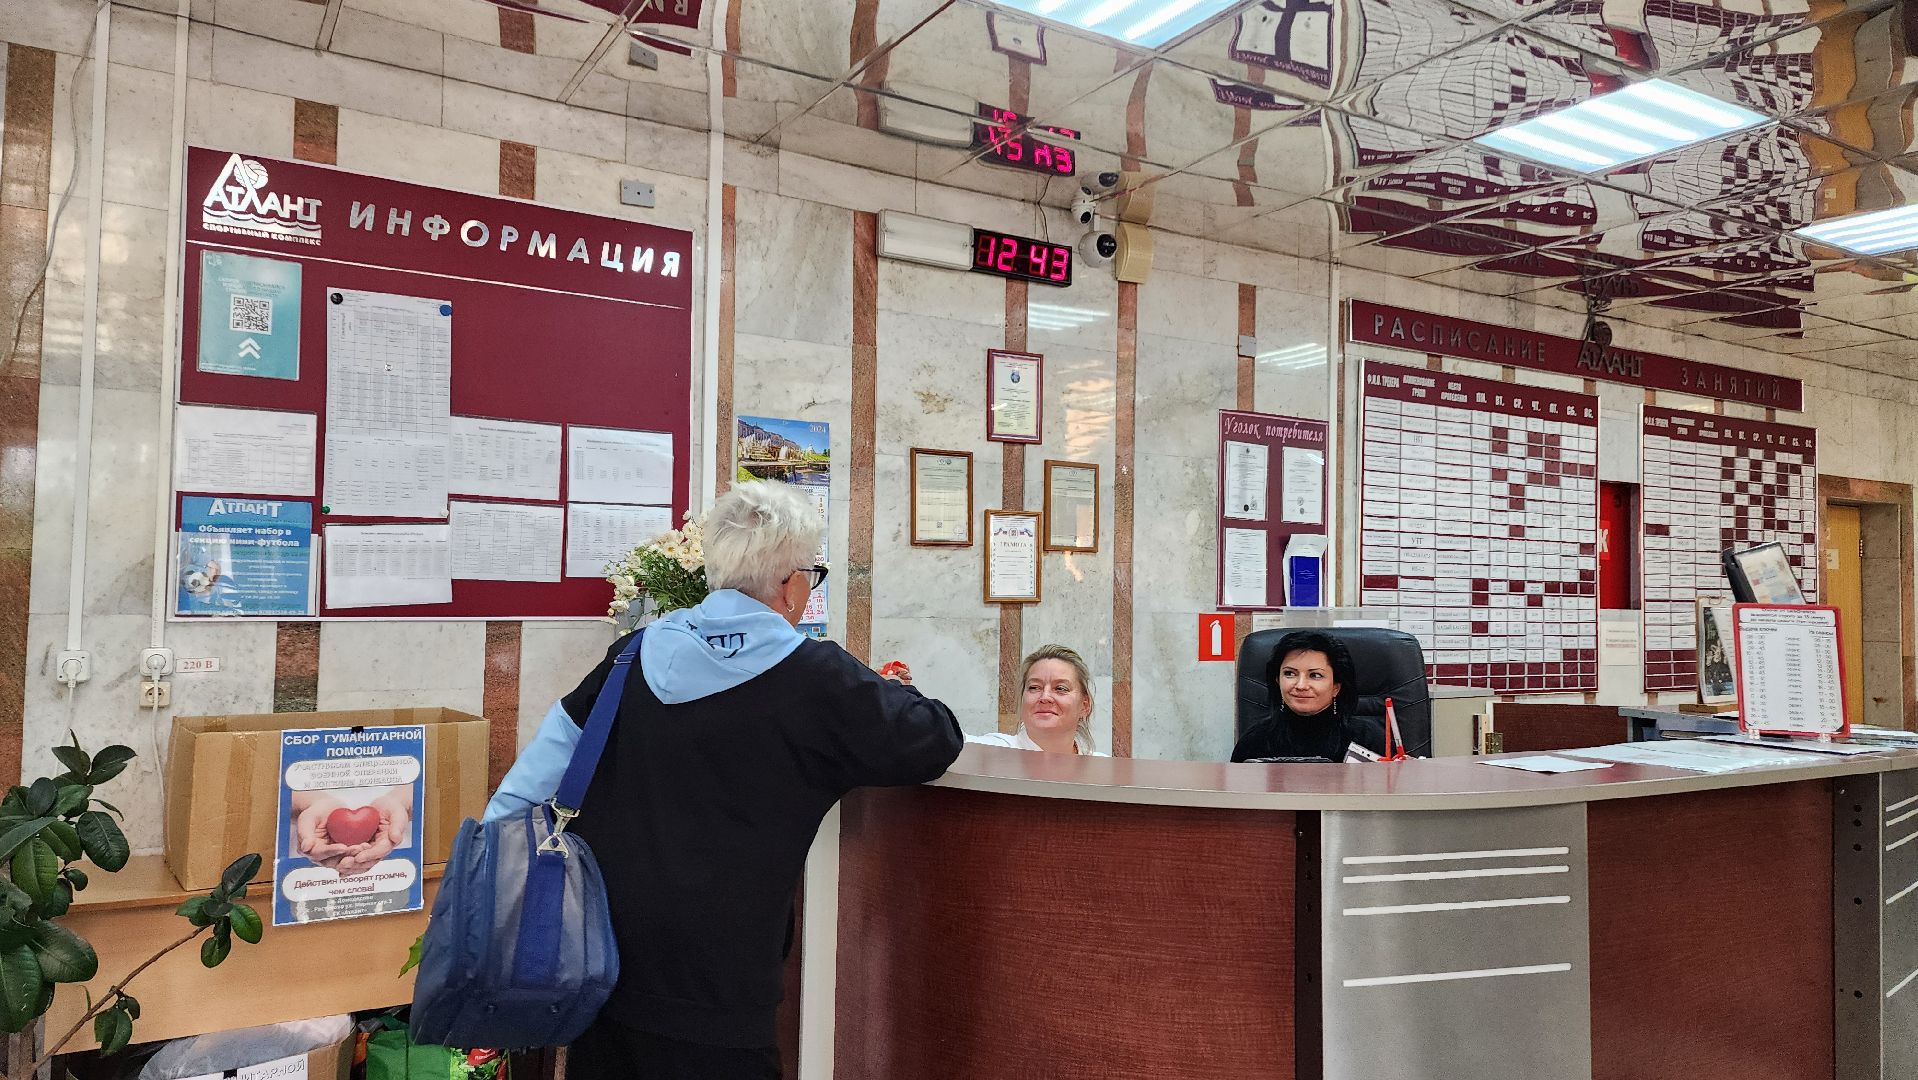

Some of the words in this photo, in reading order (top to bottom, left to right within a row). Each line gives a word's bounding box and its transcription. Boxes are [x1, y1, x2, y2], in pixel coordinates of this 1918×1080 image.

[203, 153, 323, 223] АТЛАНТ
[203, 222, 269, 239] СПОРТИВНЫЙ
[270, 231, 321, 246] КОМПЛЕКС
[349, 200, 681, 278] ИНФОРМАЦИЯ
[1373, 313, 1547, 363] РАСПИСАНИЕ
[1681, 366, 1780, 401] ЗАНЯТИЙ
[1225, 417, 1261, 439] Уголок
[1265, 422, 1324, 443] потребителя
[199, 525, 253, 535] Объявляет
[254, 528, 284, 537] набор
[189, 537, 227, 545] секцию
[229, 538, 300, 548] мини-футбола
[183, 661, 202, 669] 220
[205, 660, 213, 669] В
[283, 733, 320, 746] СБОР
[324, 728, 422, 744] ГУМАНИТАРНОЙ
[326, 745, 383, 758] ПОМОЩИ
[294, 878, 338, 890] Действия
[339, 875, 373, 885] говорят
[375, 871, 407, 882] громче,
[328, 888, 345, 896] чем
[347, 883, 375, 893] слова!
